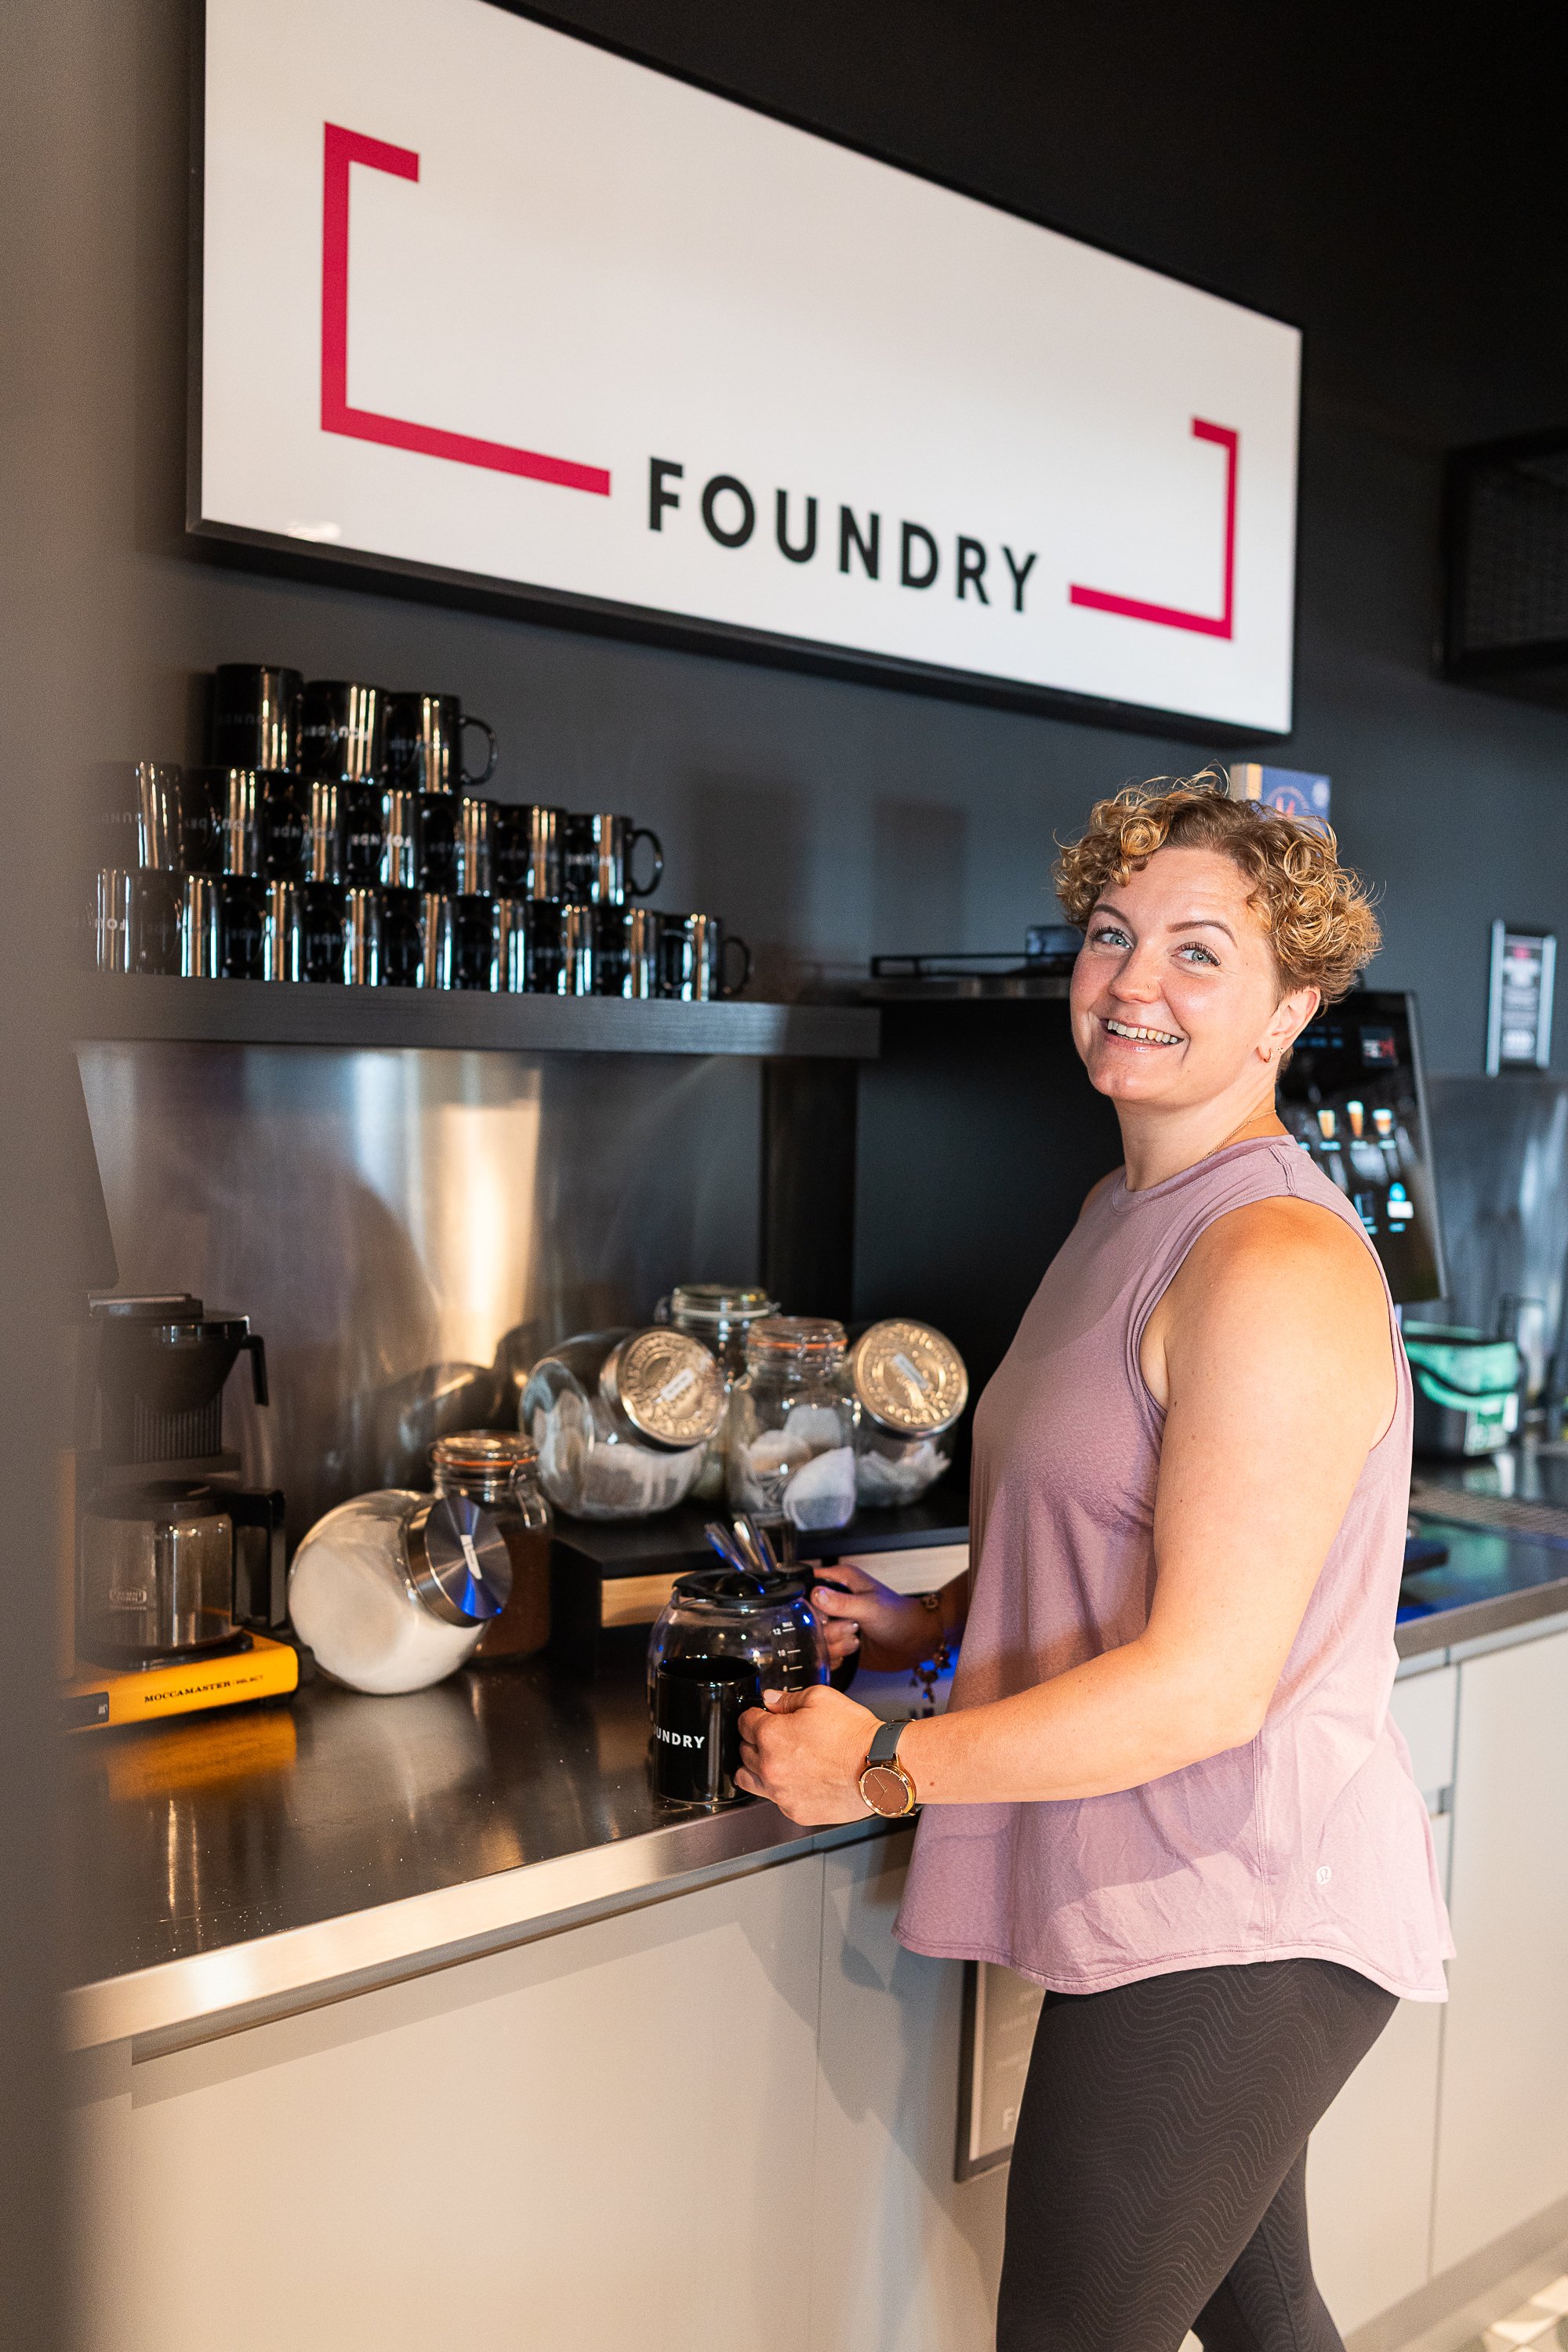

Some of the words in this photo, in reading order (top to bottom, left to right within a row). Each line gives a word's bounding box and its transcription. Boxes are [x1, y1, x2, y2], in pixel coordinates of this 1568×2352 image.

[648, 456, 1038, 613] FOUNDRY
[144, 1681, 230, 1703] MOCCAMASTER
[653, 1723, 706, 1749] UNDRY
